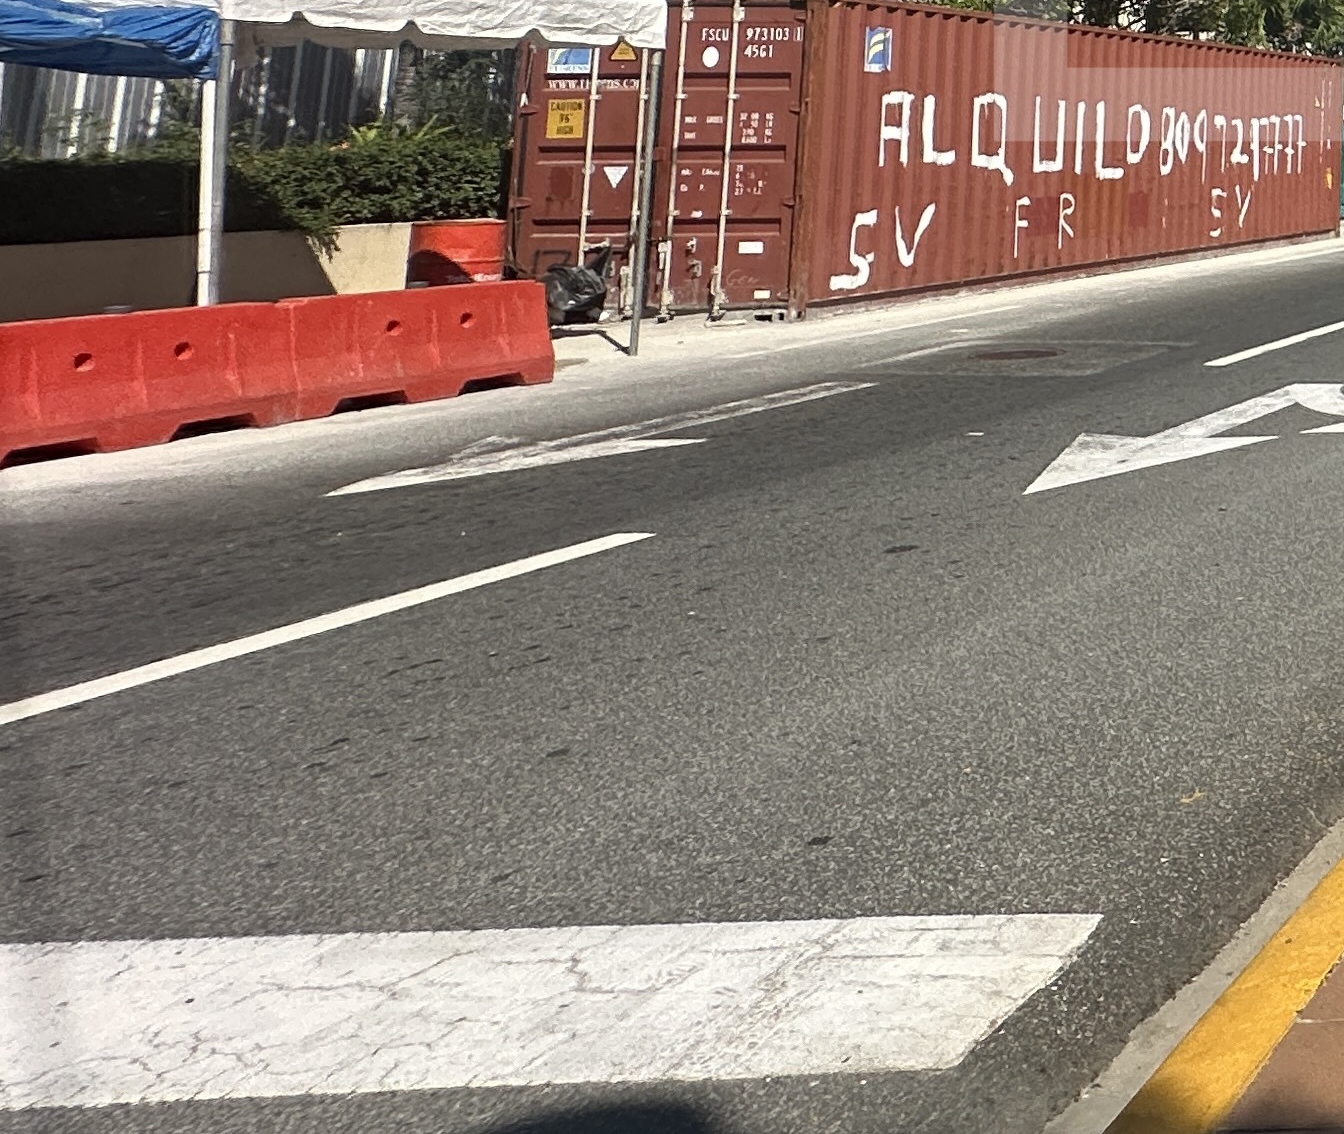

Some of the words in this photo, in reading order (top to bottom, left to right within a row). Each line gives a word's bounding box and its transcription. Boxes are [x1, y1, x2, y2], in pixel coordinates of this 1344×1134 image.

[702, 28, 729, 41] FSCU
[746, 27, 790, 41] 973103
[879, 90, 1150, 187] ALQUILO
